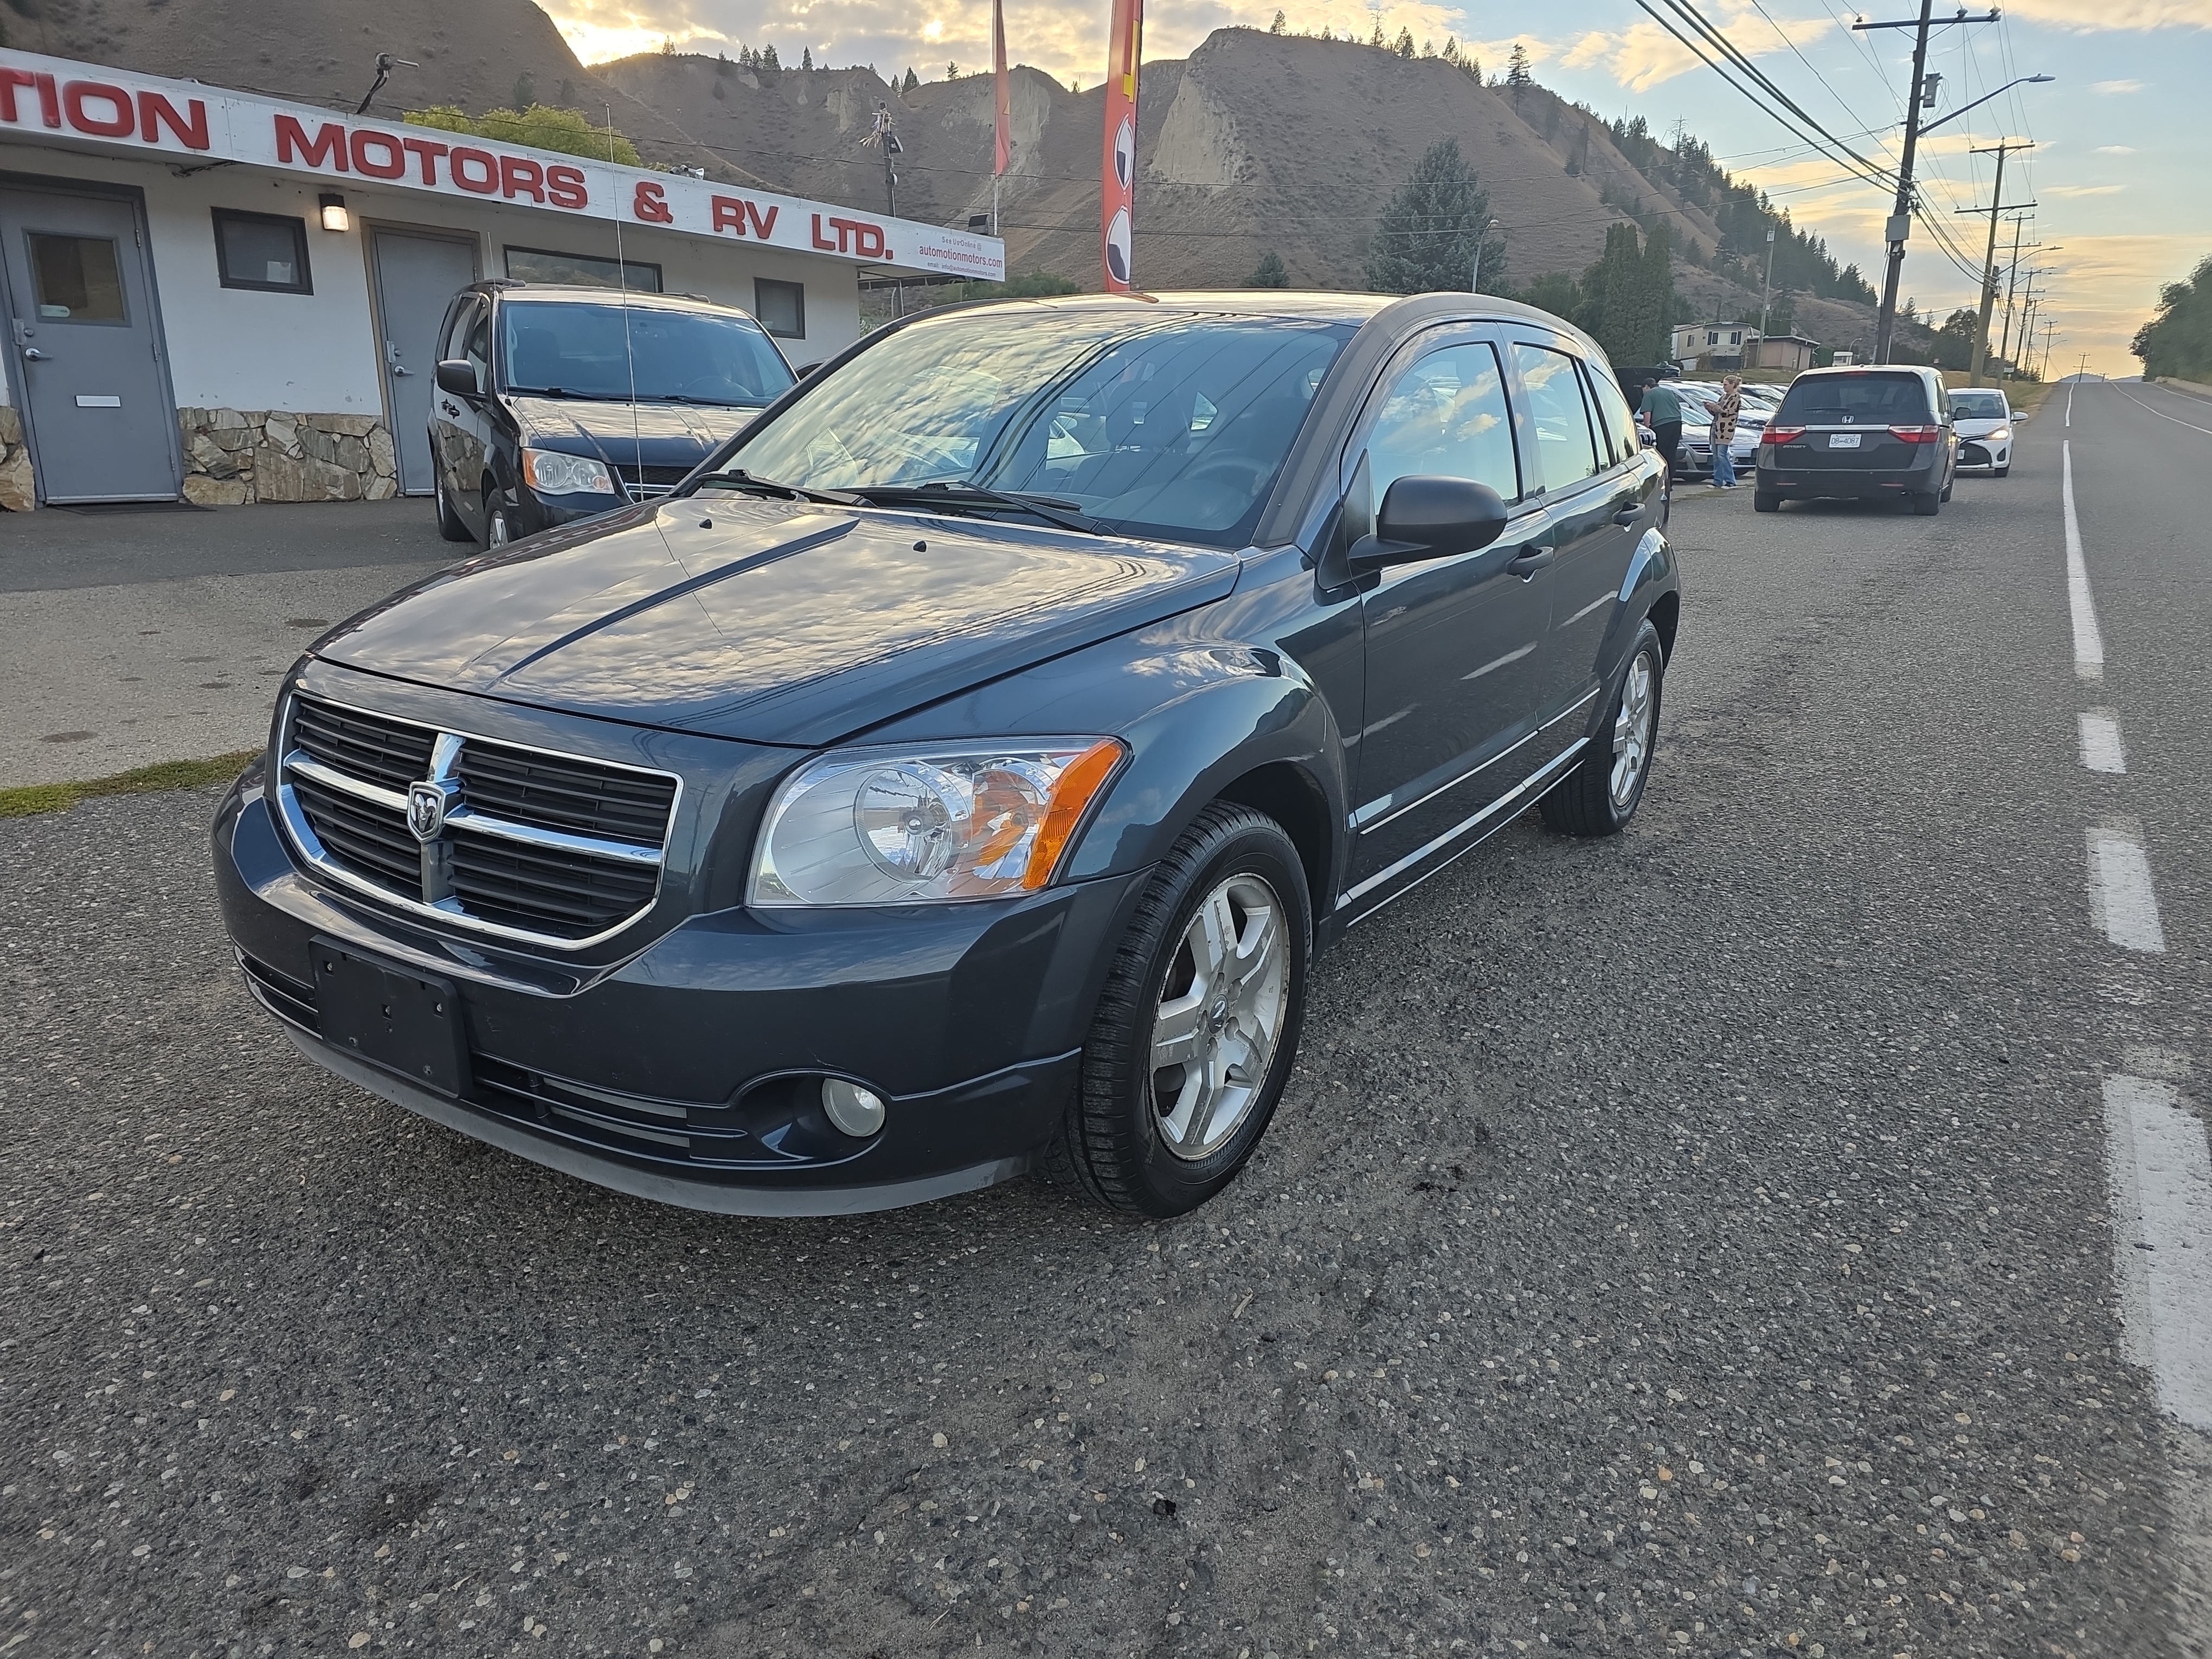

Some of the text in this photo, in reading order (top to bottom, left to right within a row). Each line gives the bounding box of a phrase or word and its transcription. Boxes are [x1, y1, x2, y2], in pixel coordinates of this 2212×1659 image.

[0, 66, 893, 260] TION MOTORS & RV LTD.
[942, 236, 952, 245] See
[960, 240, 976, 249] Online
[977, 243, 982, 251] @
[919, 245, 1003, 268] automotionmotors.com
[941, 263, 996, 277] info@automotionmotors.com
